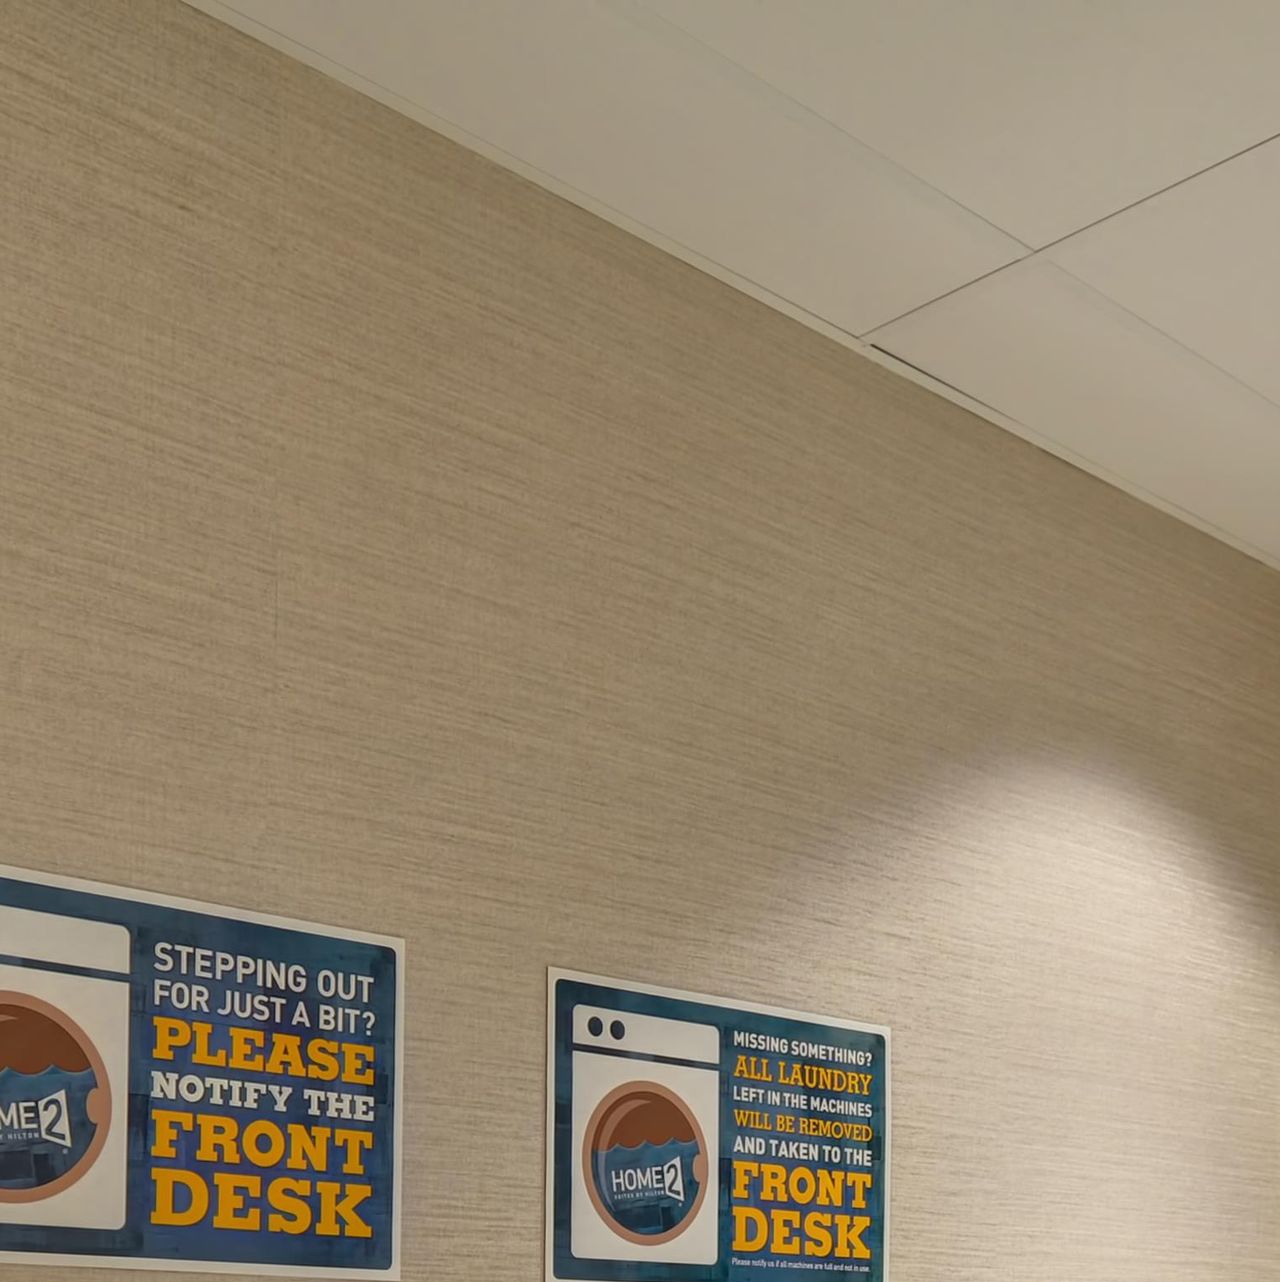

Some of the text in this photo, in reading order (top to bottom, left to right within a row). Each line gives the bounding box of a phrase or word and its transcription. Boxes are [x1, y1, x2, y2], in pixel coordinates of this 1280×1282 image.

[153, 942, 374, 1004] STEPPING OUT
[153, 979, 376, 1037] FOR JUST A BIT?
[152, 1016, 375, 1086] PLEASE
[733, 1030, 873, 1067] MISSING SOMETHING?
[150, 1070, 375, 1122] NOTIFY THE
[733, 1055, 873, 1096] ALL LAUNDRY
[733, 1085, 873, 1118] LEFT IN THE MACHINES
[150, 1110, 374, 1176] FRONT
[733, 1108, 873, 1142] WILL BE REMOVED
[733, 1135, 873, 1167] AND TAKEN TO THE
[149, 1167, 374, 1239] DESK
[732, 1160, 871, 1208] FRONT
[731, 1206, 871, 1259] DESK
